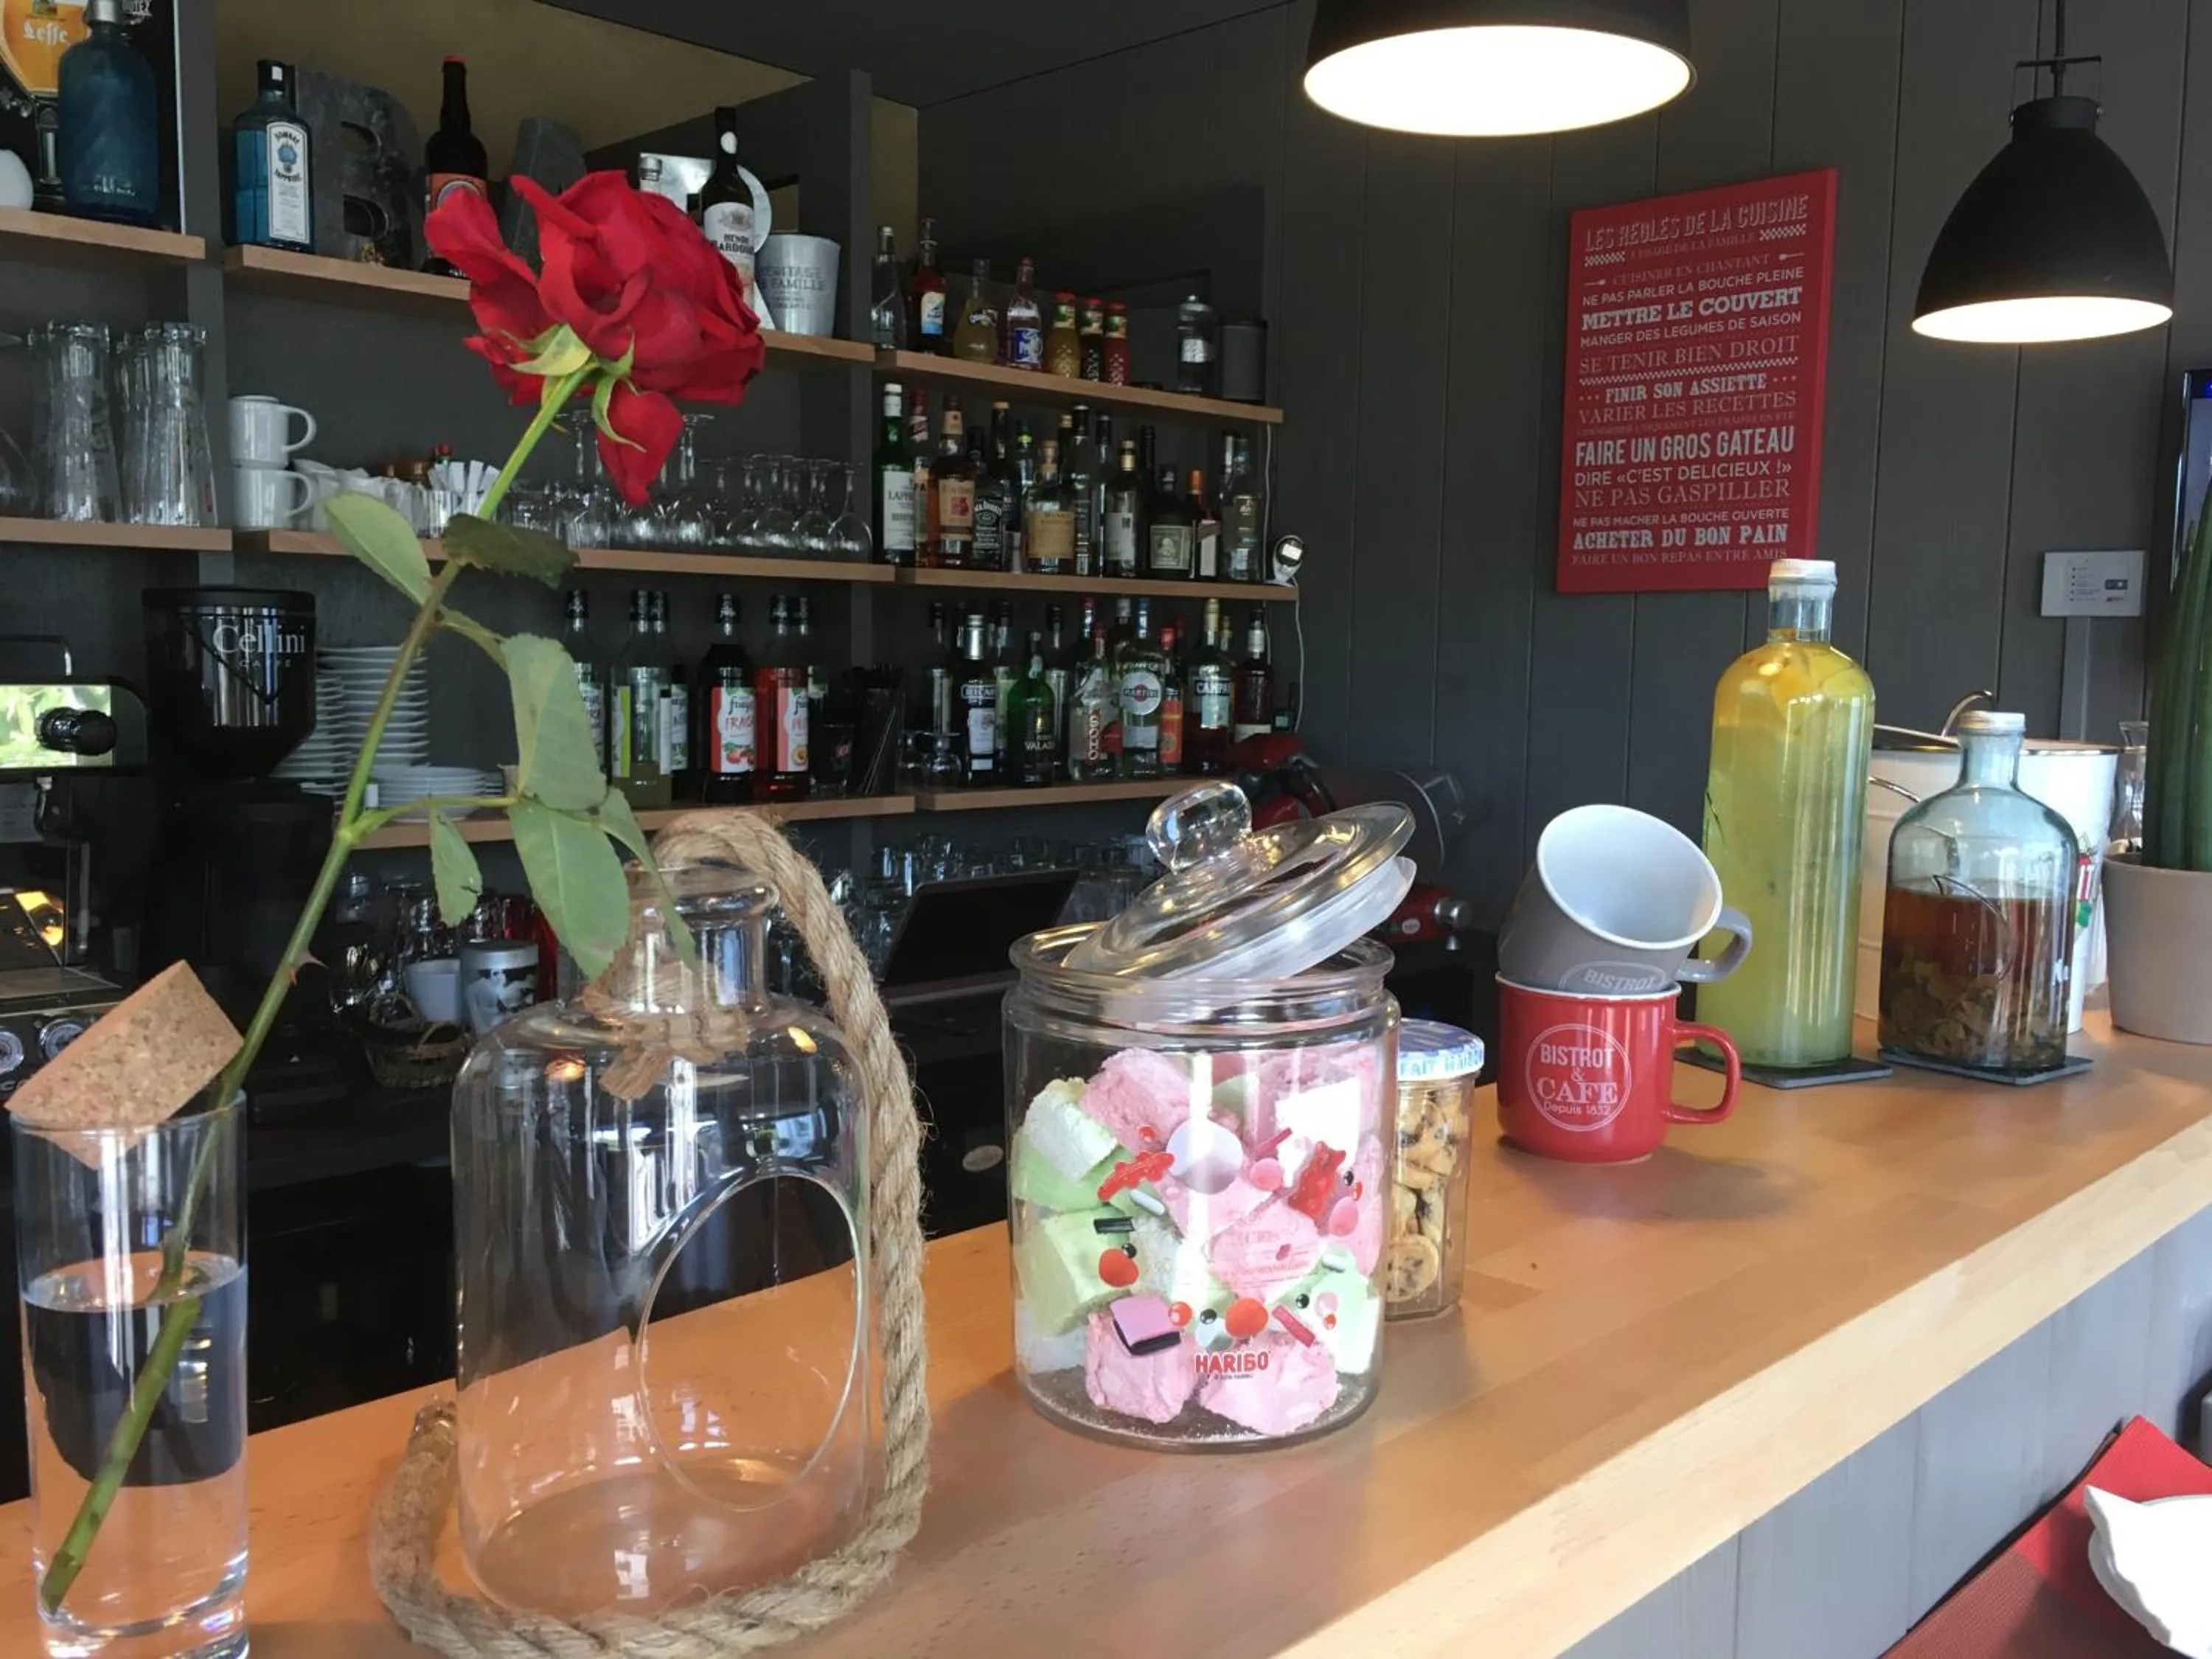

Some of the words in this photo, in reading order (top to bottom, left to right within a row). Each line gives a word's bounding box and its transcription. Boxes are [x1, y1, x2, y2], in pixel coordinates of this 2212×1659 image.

[24, 20, 72, 46] Leffe
[1685, 211, 1708, 237] DE
[1711, 207, 1733, 233] LA
[1738, 194, 1809, 229] CUISINE
[1676, 263, 1693, 277] EN
[1697, 254, 1771, 274] CHANTANT
[1582, 293, 1599, 306] NE
[1601, 289, 1625, 305] PAS
[1627, 284, 1675, 301] PARLER
[1678, 282, 1694, 294] LA
[1698, 274, 1753, 291] BOUCHE
[1756, 265, 1805, 283] PLEINE
[1582, 305, 1662, 331] METTRE
[1667, 299, 1694, 321] LE
[1699, 285, 1803, 317] COUVERT
[1580, 332, 1633, 348] MANGER
[1636, 327, 1660, 341] DES
[1663, 319, 1725, 339] LEGUMES
[1728, 318, 1746, 330] DE
[1750, 311, 1802, 329] SAISON
[1579, 358, 1602, 375] SE
[1607, 349, 1667, 372] TENIR
[1674, 344, 1723, 365] BIEN
[1730, 334, 1800, 360] DROIT
[1605, 384, 1648, 404] FINIR
[1652, 380, 1683, 399] SON
[1689, 372, 1767, 397] ASSIETTE
[1579, 405, 1647, 425] VARIER
[1652, 401, 1686, 419] LES
[1691, 390, 1798, 415] RECETTES
[1576, 439, 1626, 467] FAIRE
[1630, 437, 1656, 464] UN
[1661, 431, 1712, 461] GROS
[1717, 425, 1795, 457] GATEAU
[1574, 470, 1611, 487] DIRE
[1677, 460, 1770, 481] DELICIEUX
[1575, 490, 1605, 509] NE
[1611, 487, 1650, 507] PAS
[1658, 479, 1790, 504] GASPILLER
[1573, 517, 1587, 529] NE
[1590, 516, 1611, 528] PAS
[1614, 514, 1660, 526] MACHER
[1662, 513, 1677, 524] LA
[1680, 510, 1729, 524] BOUCHE
[1732, 507, 1790, 522] OUVERTE
[1573, 530, 1654, 551] ACHETER
[1660, 529, 1687, 546] DU
[1694, 526, 1731, 546] BON
[1739, 523, 1788, 544] PAIN
[1572, 553, 1609, 566] FAIRE
[1611, 553, 1631, 565] UN
[1633, 552, 1658, 564] BON
[1661, 550, 1702, 563] REPAS
[1705, 549, 1749, 561] ENTRE
[1755, 548, 1788, 560] AMIS
[1086, 714, 1099, 762] SOHO
[1585, 967, 1655, 992] BISTROT
[1400, 1057, 1439, 1076] FAIT
[1540, 1043, 1615, 1068] BISTROT
[1571, 1067, 1585, 1082] &
[1536, 1077, 1618, 1105] CAFE
[1543, 1100, 1582, 1115] Depuis
[1194, 1351, 1270, 1374] HARIBO
